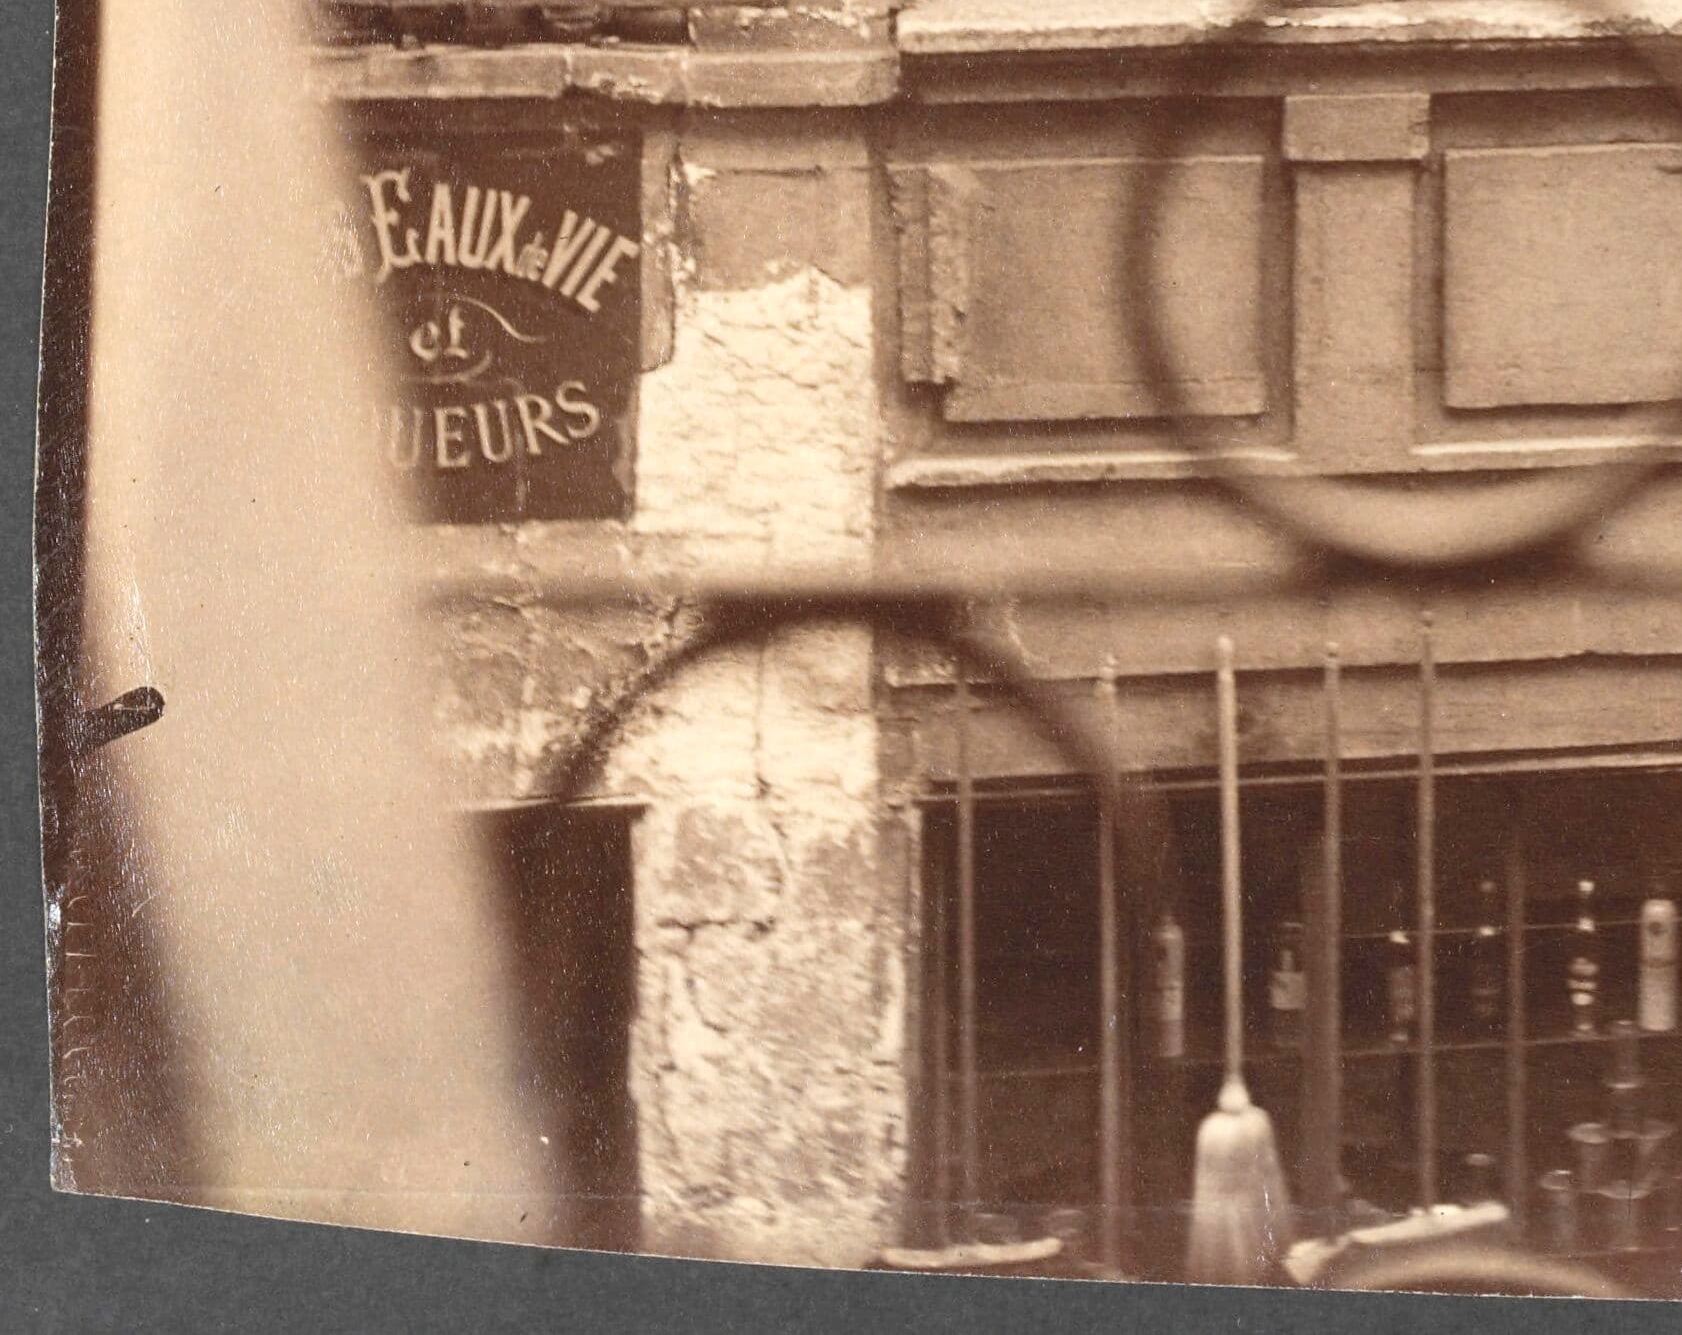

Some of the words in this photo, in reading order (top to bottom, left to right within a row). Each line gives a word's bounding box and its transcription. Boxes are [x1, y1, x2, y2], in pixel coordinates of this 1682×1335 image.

[360, 167, 531, 282] EAUX
[541, 209, 640, 313] VIE
[408, 304, 470, 362] et
